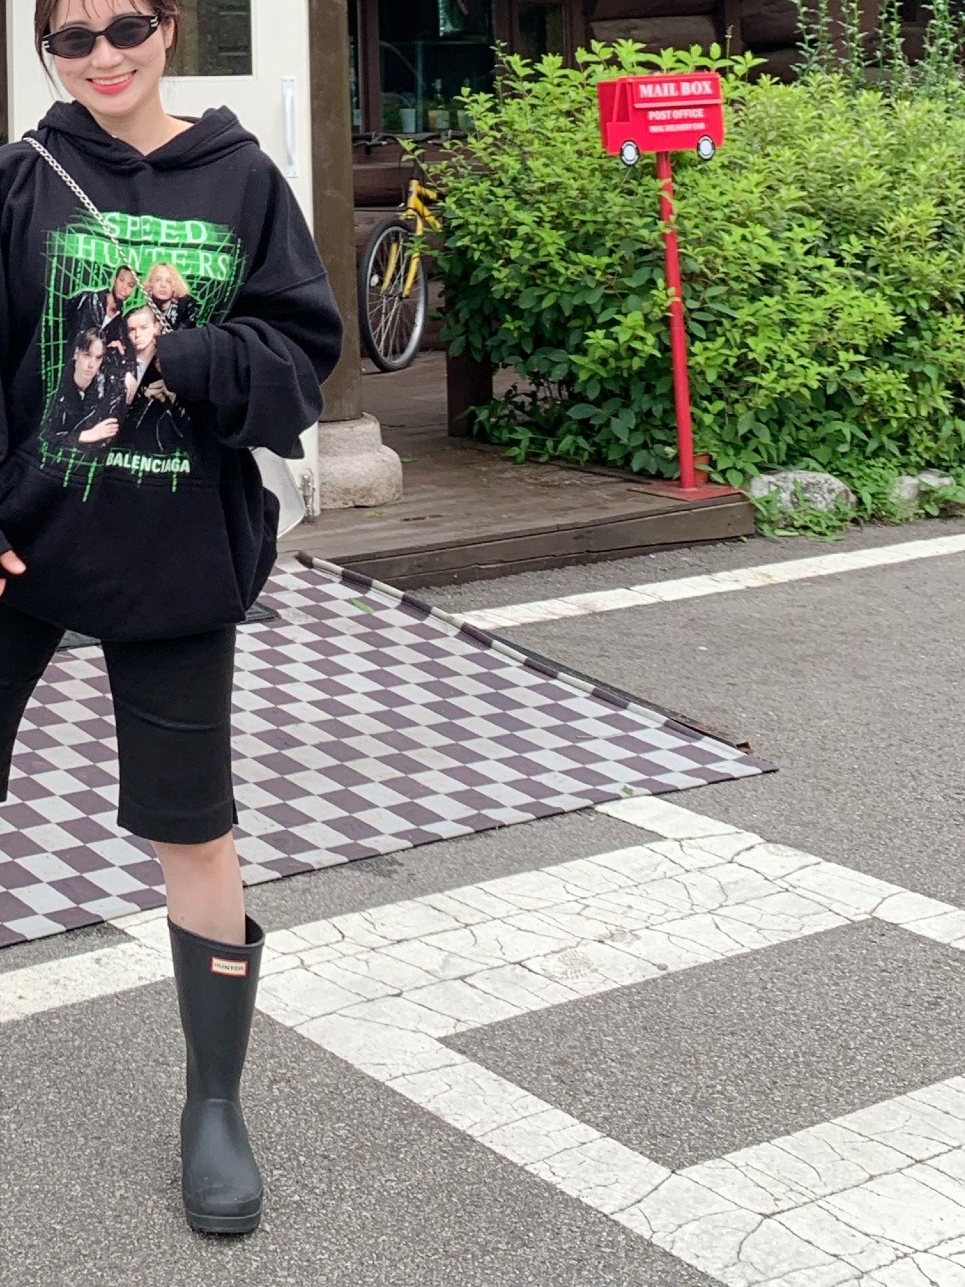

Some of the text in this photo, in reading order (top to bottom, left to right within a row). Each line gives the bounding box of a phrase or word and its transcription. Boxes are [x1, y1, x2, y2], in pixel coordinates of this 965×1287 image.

[639, 81, 712, 98] MAIL BOX
[648, 108, 704, 120] POST OFFICE
[104, 212, 208, 244] SPEED
[77, 233, 231, 280] HUNTERS
[105, 451, 191, 473] BALENCIAGA
[214, 962, 244, 972] HUNTER
